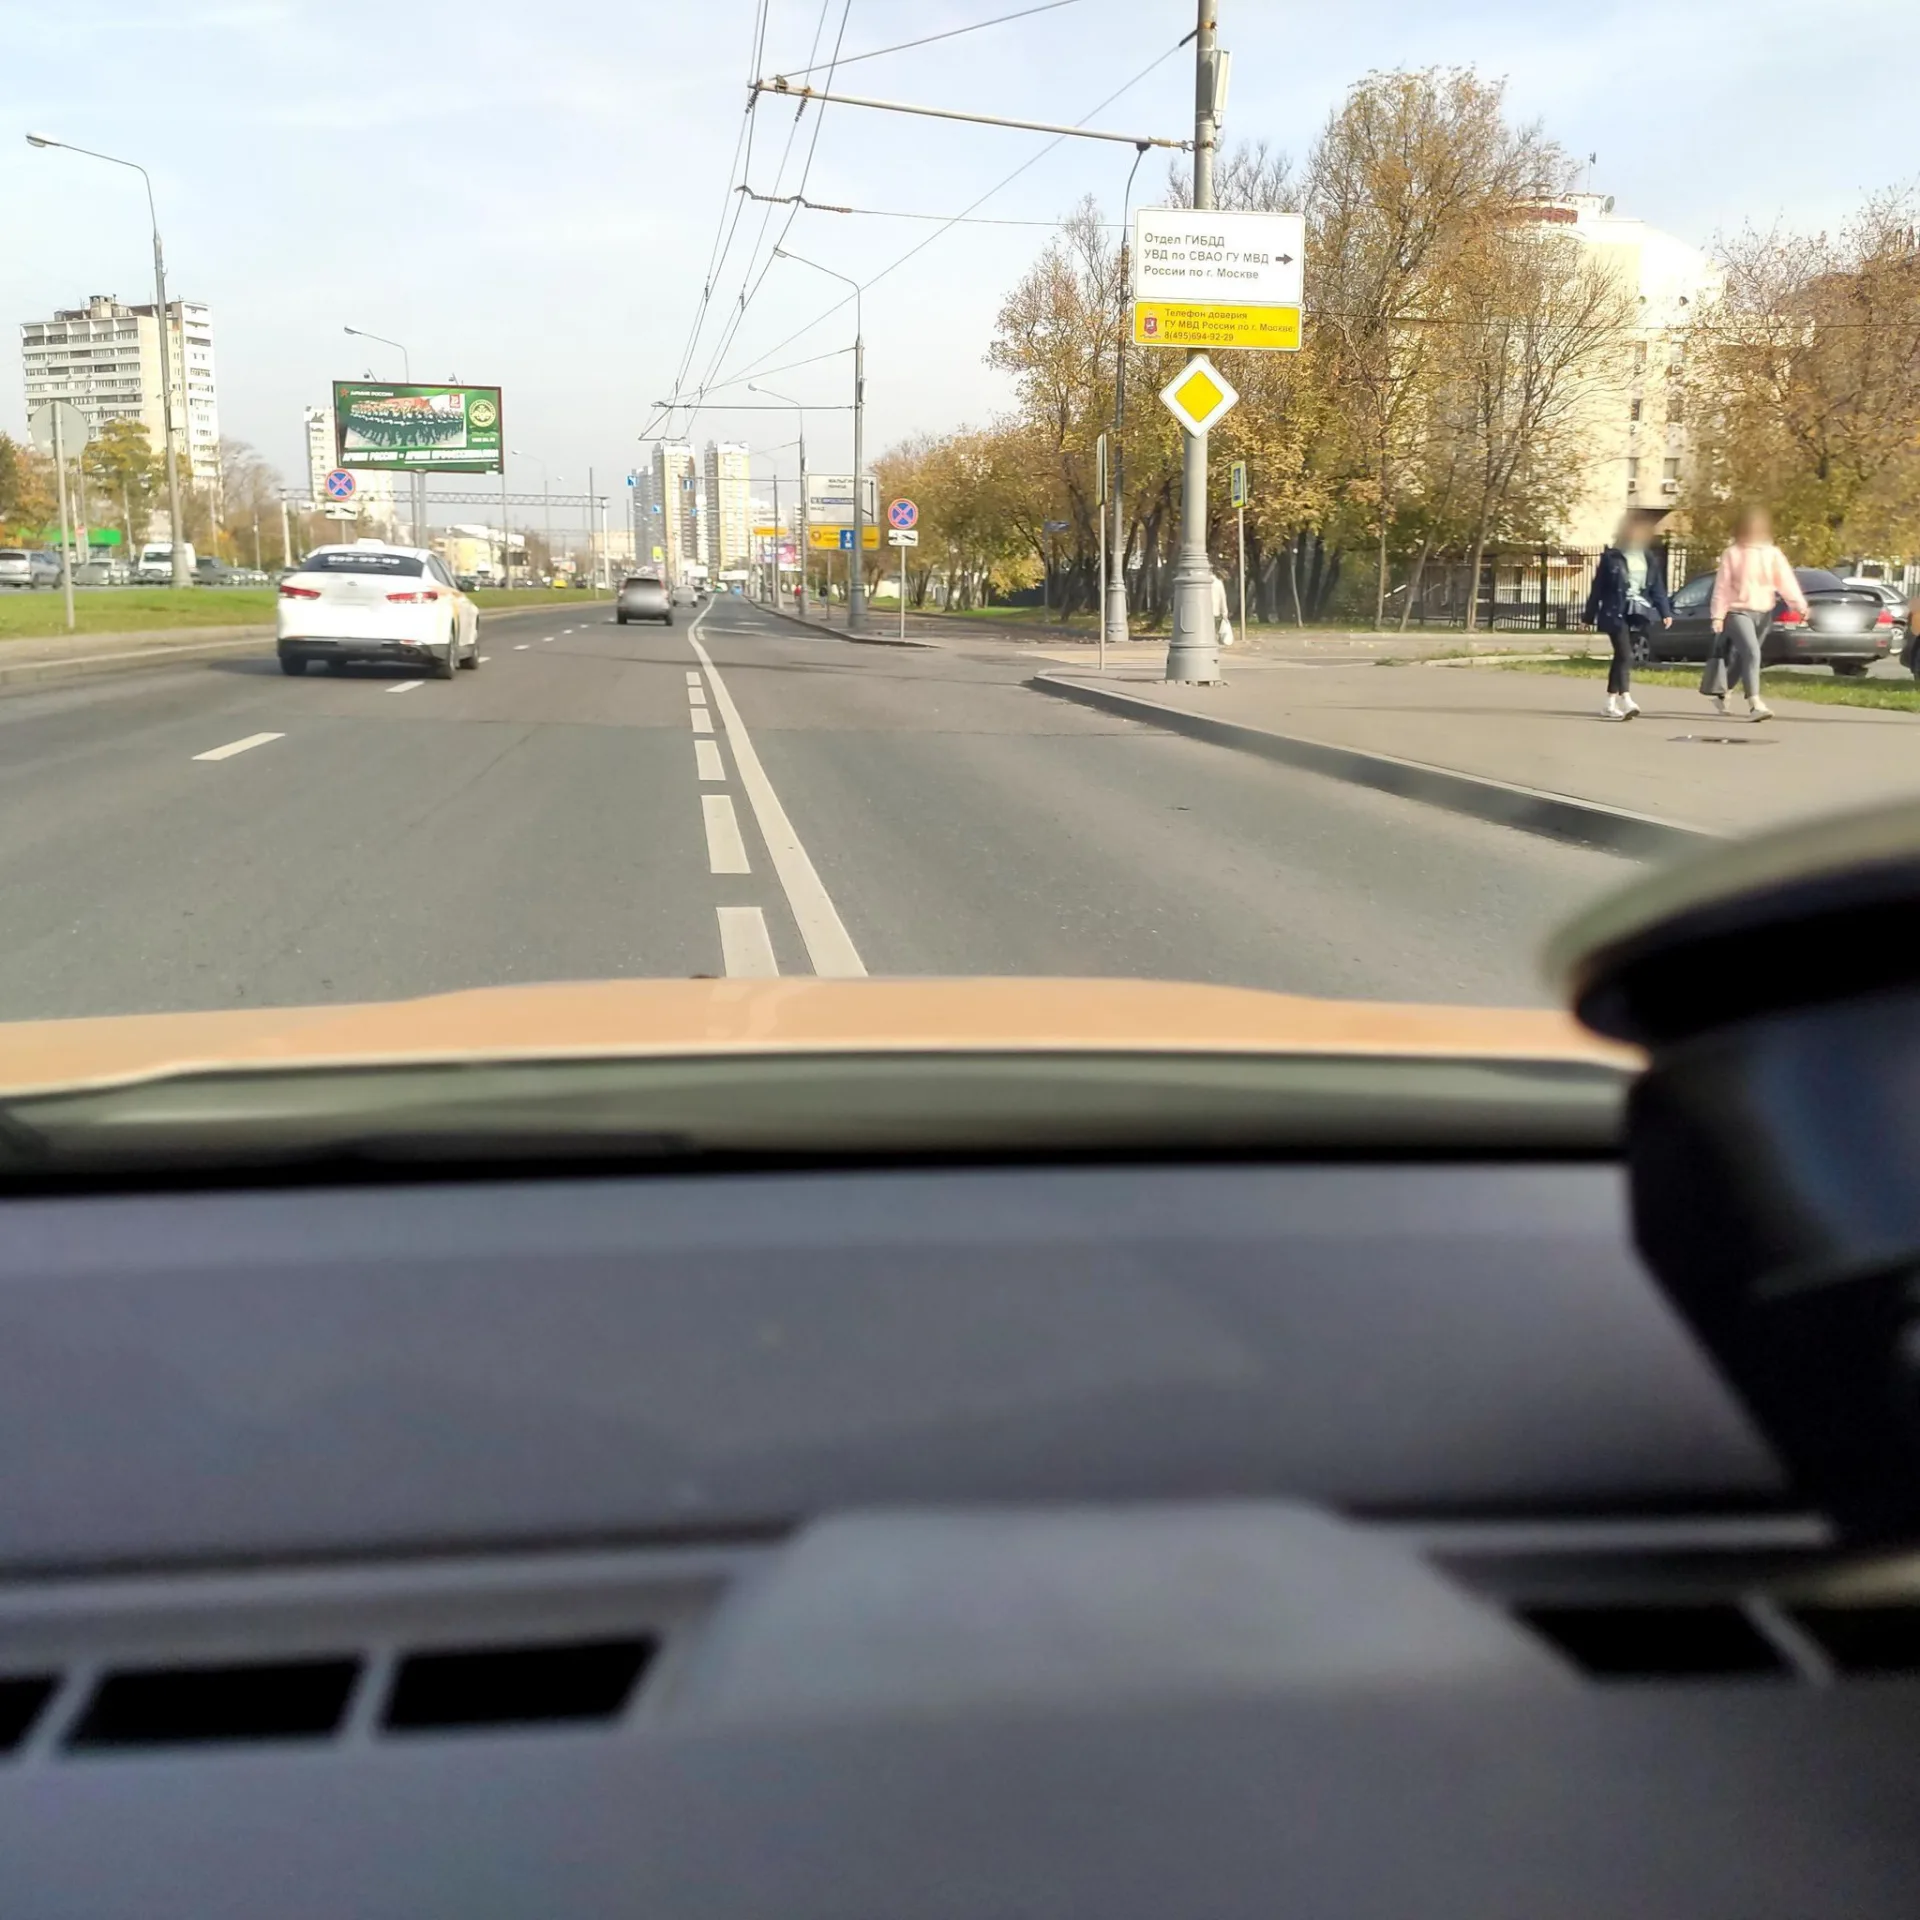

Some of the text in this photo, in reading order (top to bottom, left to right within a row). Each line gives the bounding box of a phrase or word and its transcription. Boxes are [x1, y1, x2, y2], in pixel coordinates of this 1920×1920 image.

[1144, 232, 1225, 248] Отдел ГИБДД
[1144, 249, 1269, 265] УВД по СВАО ГУ МВД
[1144, 265, 1259, 279] России по г. Москве
[1165, 308, 1248, 320] Телефон доверия
[1165, 320, 1176, 329] ГУ
[1178, 321, 1199, 330] МВД
[1202, 321, 1235, 331] России
[1238, 323, 1249, 331] по
